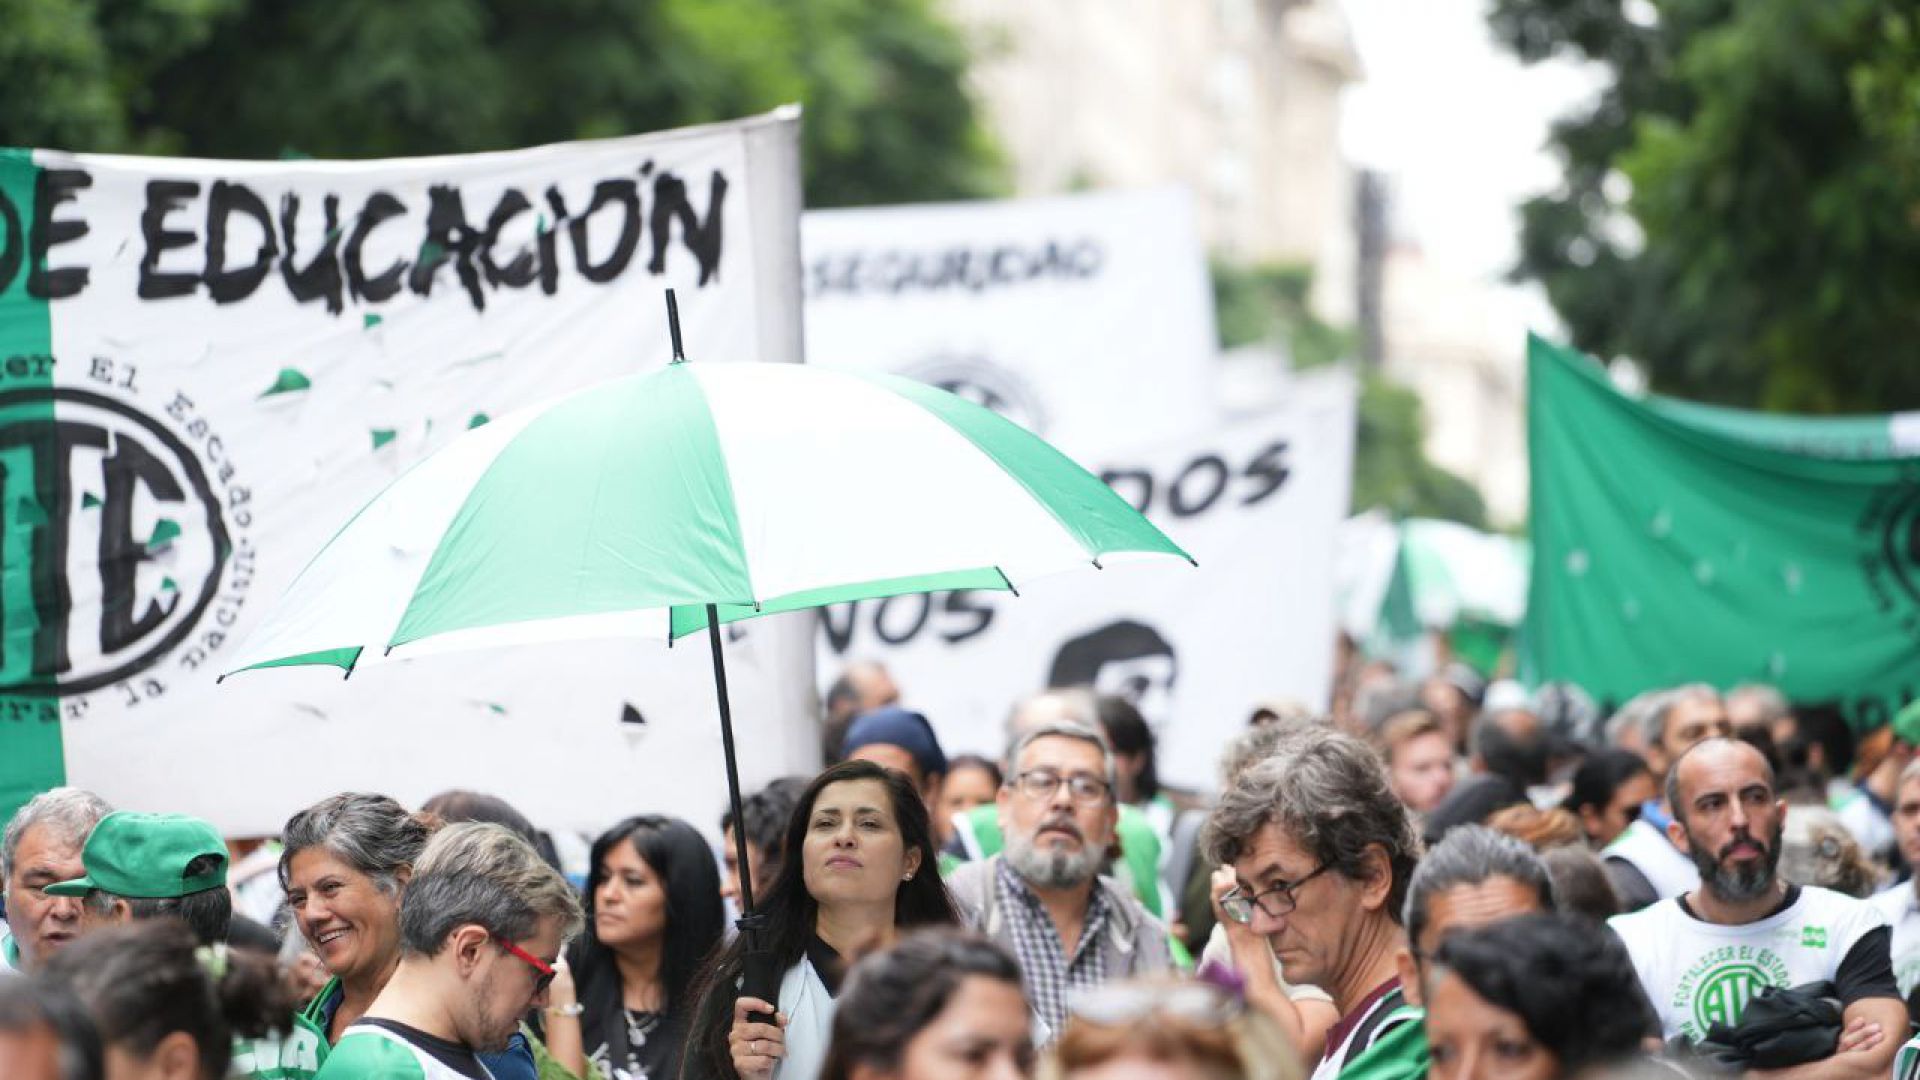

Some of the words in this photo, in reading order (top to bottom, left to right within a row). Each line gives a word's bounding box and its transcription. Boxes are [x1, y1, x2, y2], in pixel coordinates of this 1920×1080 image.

[138, 159, 729, 317] EDUCACIÓN
[0, 354, 56, 379] er
[0, 420, 186, 673] TE
